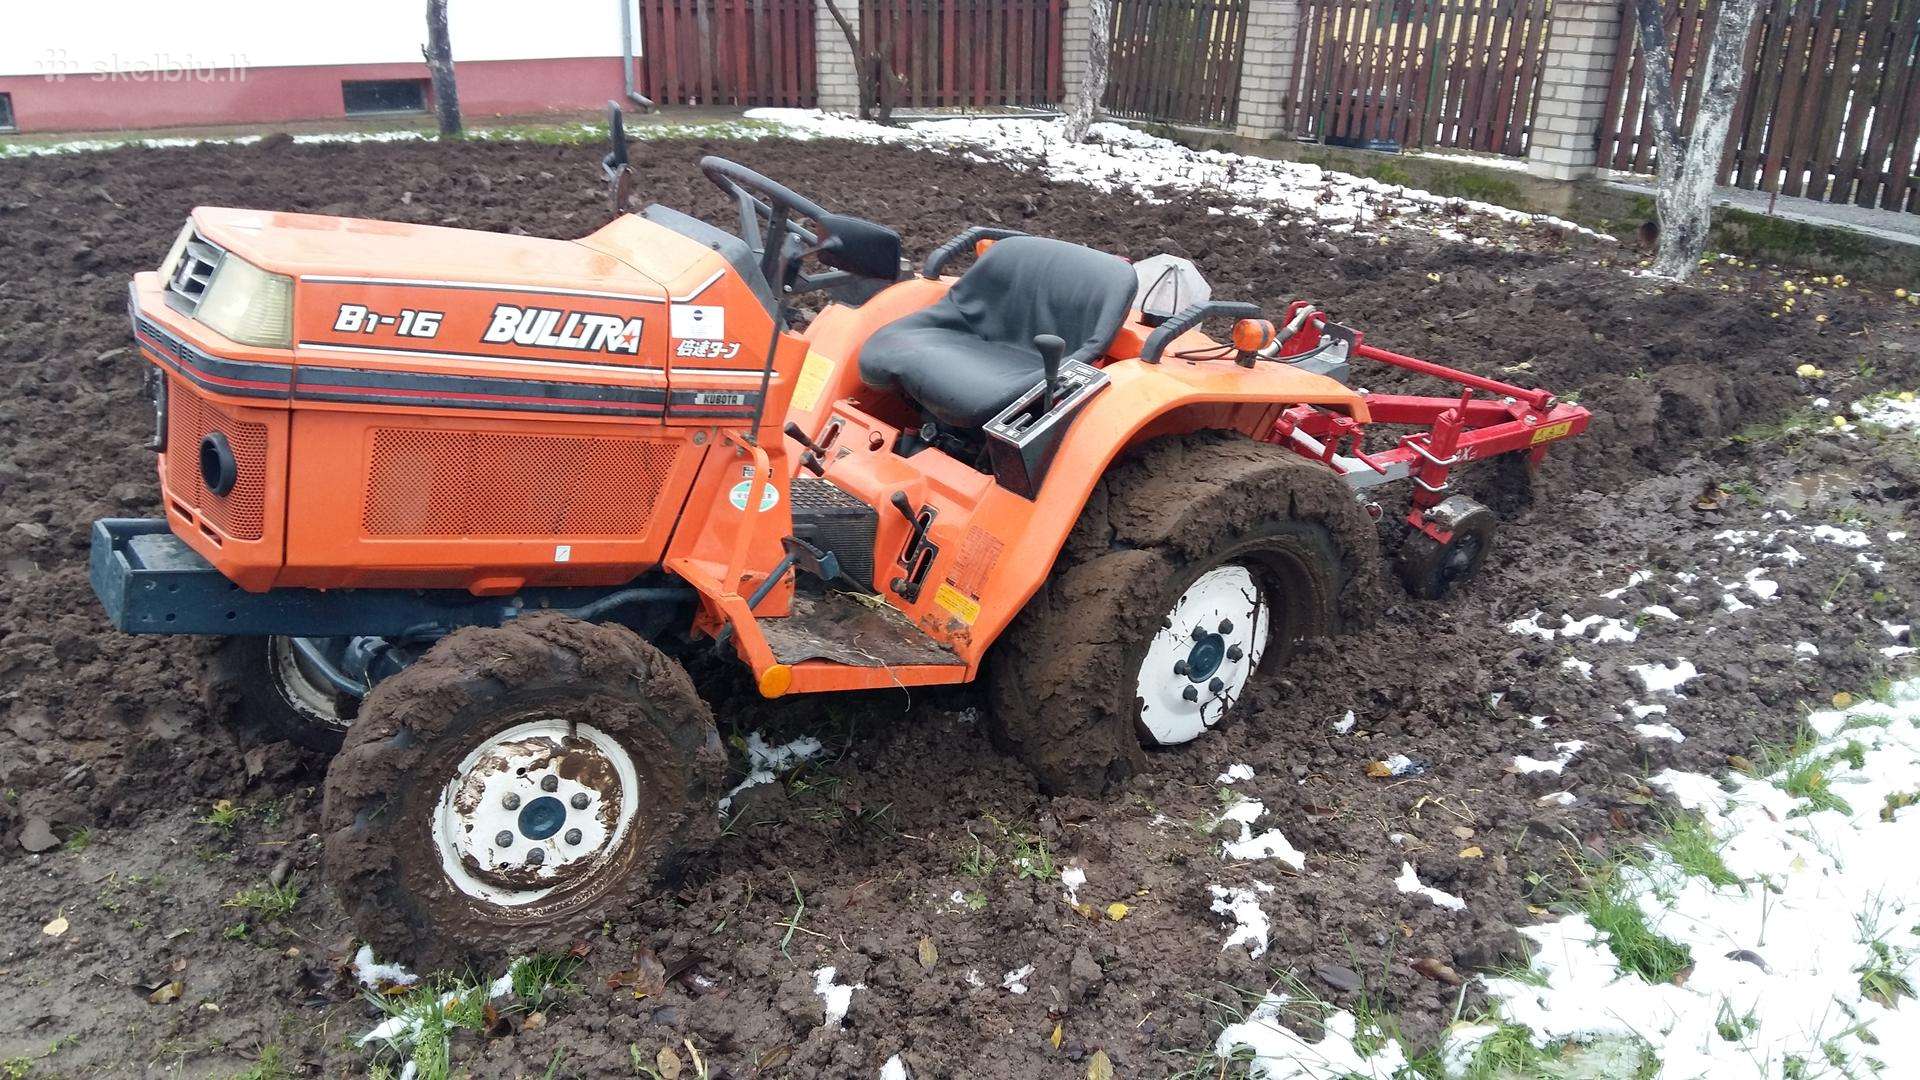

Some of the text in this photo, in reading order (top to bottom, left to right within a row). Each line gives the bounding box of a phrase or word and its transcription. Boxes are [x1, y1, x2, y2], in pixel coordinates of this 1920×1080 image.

[481, 304, 644, 353] BULLTRA
[675, 339, 741, 359] 倍速ターン
[704, 395, 738, 404] KUBOTA
